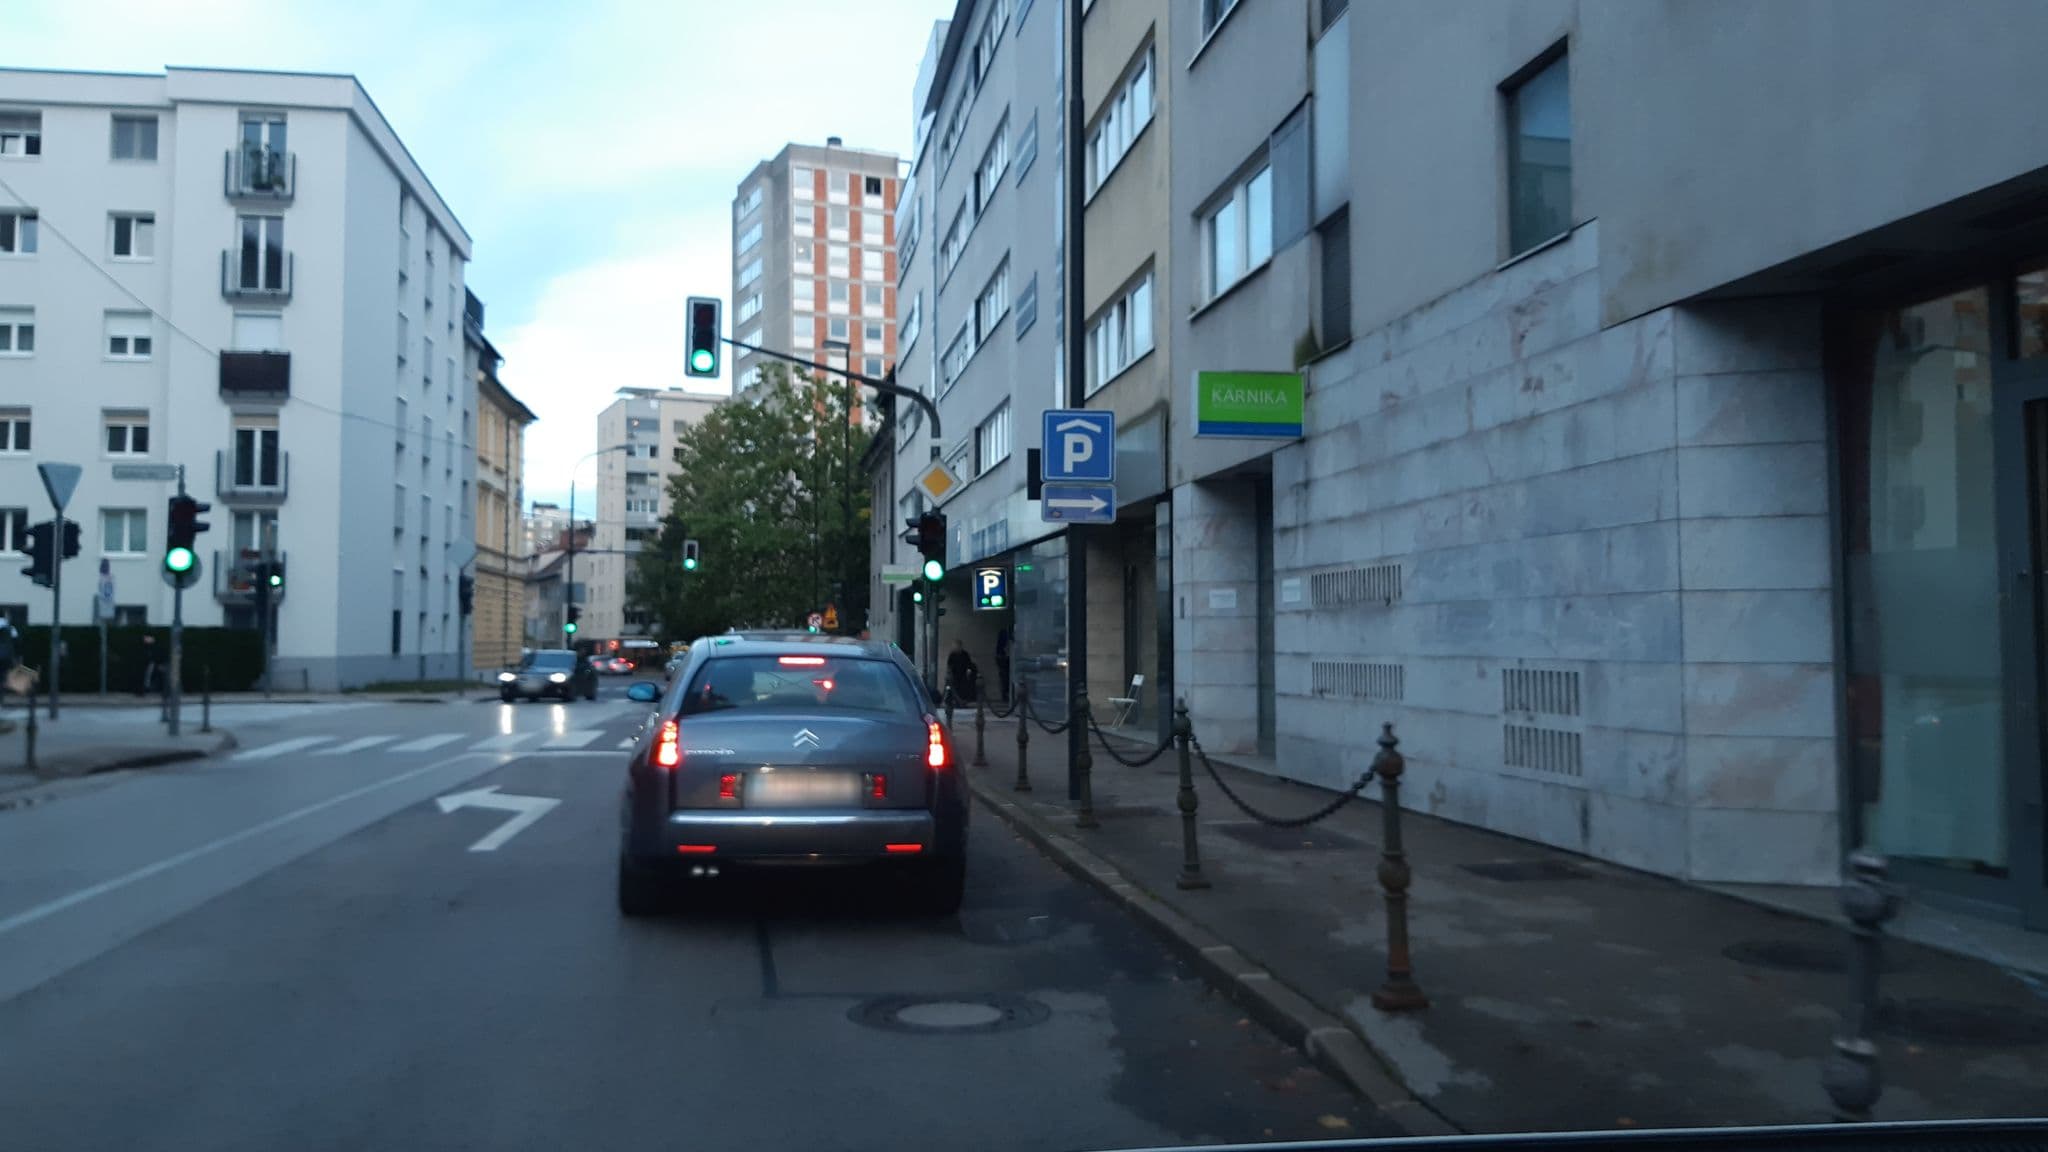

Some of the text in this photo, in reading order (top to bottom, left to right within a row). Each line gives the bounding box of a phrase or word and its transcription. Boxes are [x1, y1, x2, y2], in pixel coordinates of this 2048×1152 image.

[1212, 388, 1287, 404] KARNIKA
[1064, 433, 1093, 473] P
[984, 575, 999, 595] P
